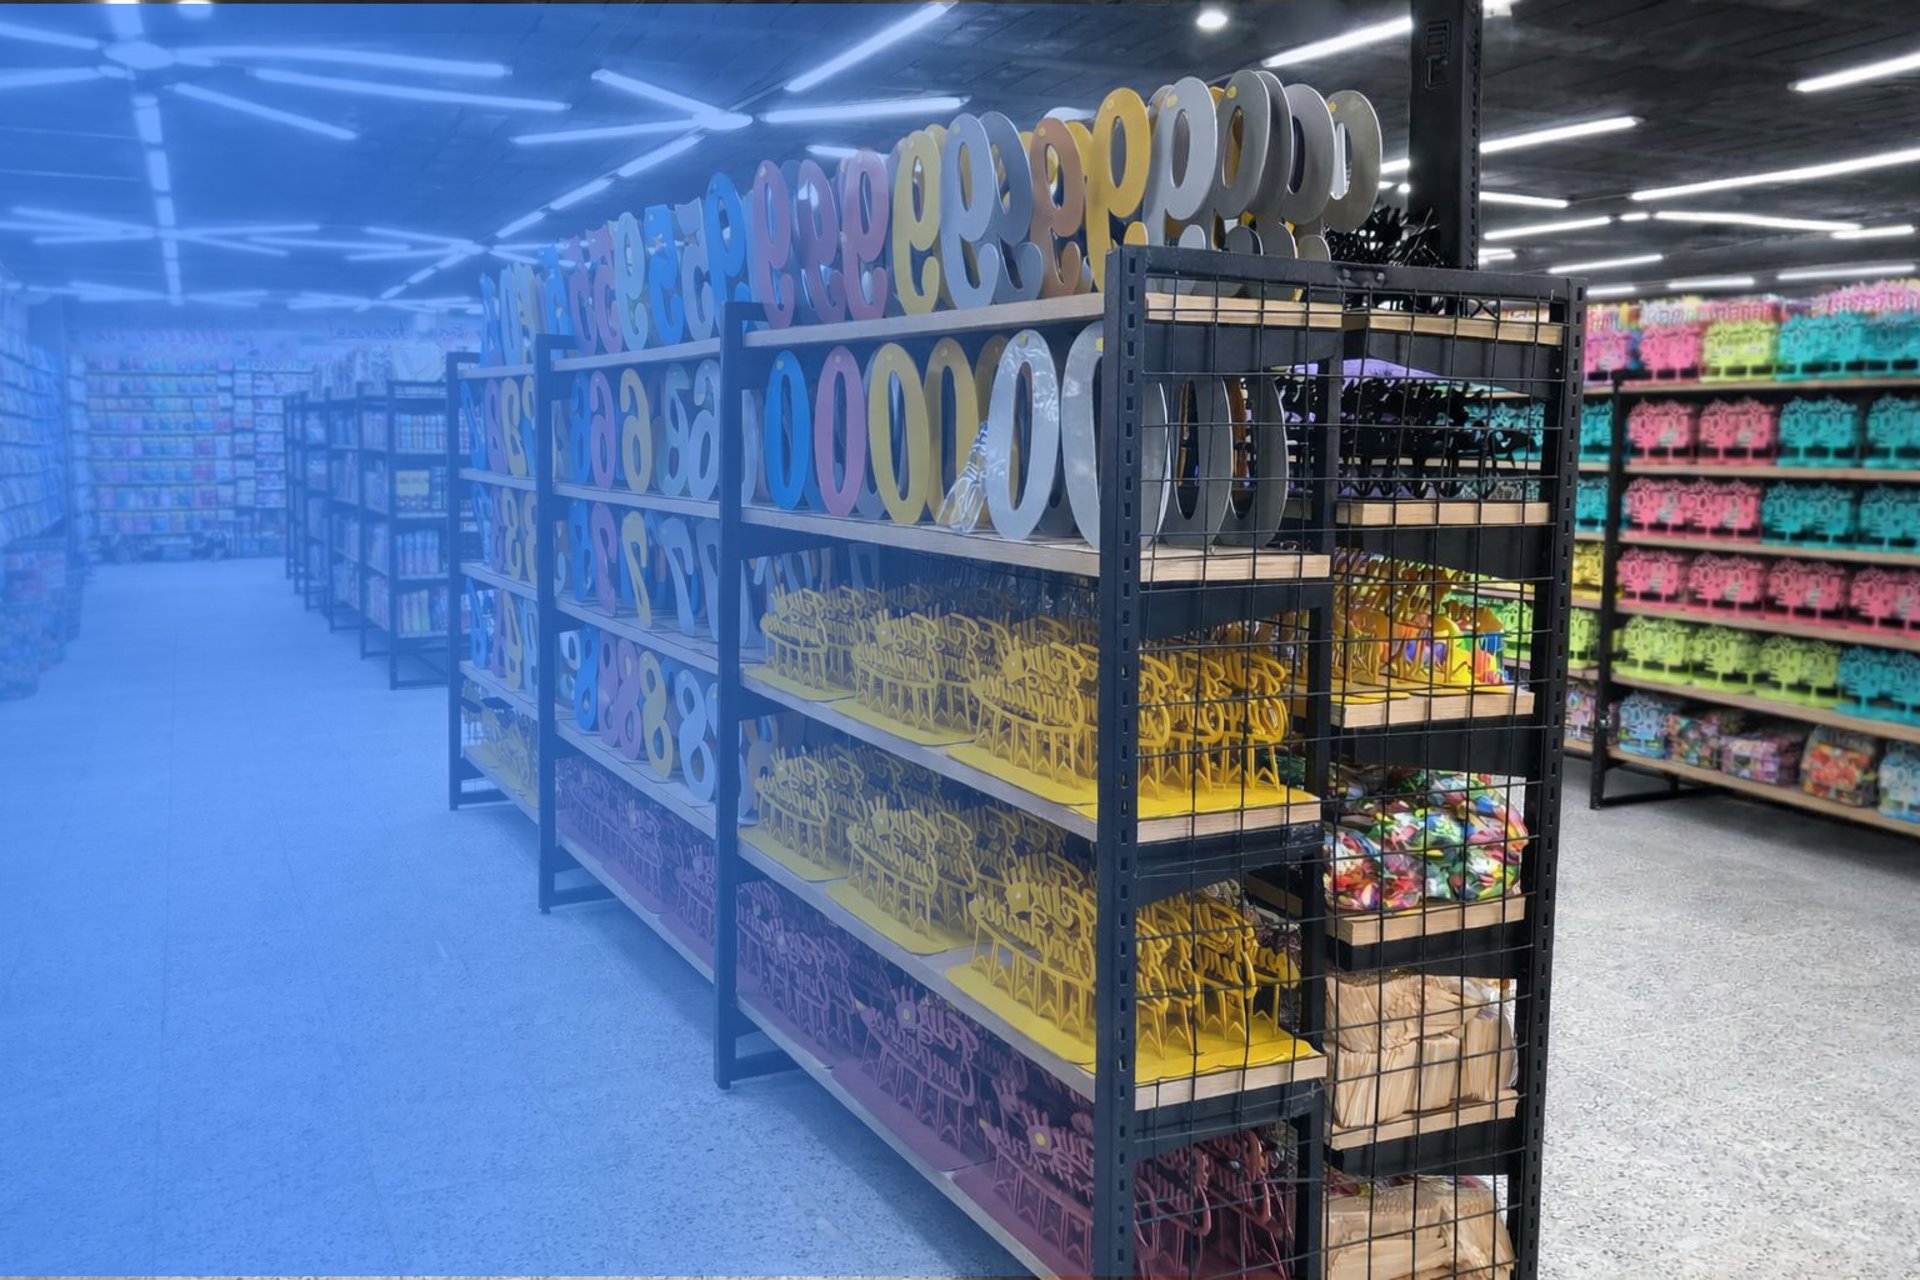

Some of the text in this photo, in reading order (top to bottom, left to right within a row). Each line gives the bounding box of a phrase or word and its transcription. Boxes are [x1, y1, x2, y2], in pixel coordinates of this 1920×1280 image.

[764, 351, 809, 510] 0
[815, 346, 866, 516] 0
[869, 342, 929, 524] 0
[988, 329, 1059, 539] 0
[576, 624, 600, 730] 8
[617, 638, 642, 760] 8
[639, 650, 673, 780] 8
[674, 669, 716, 802] 8
